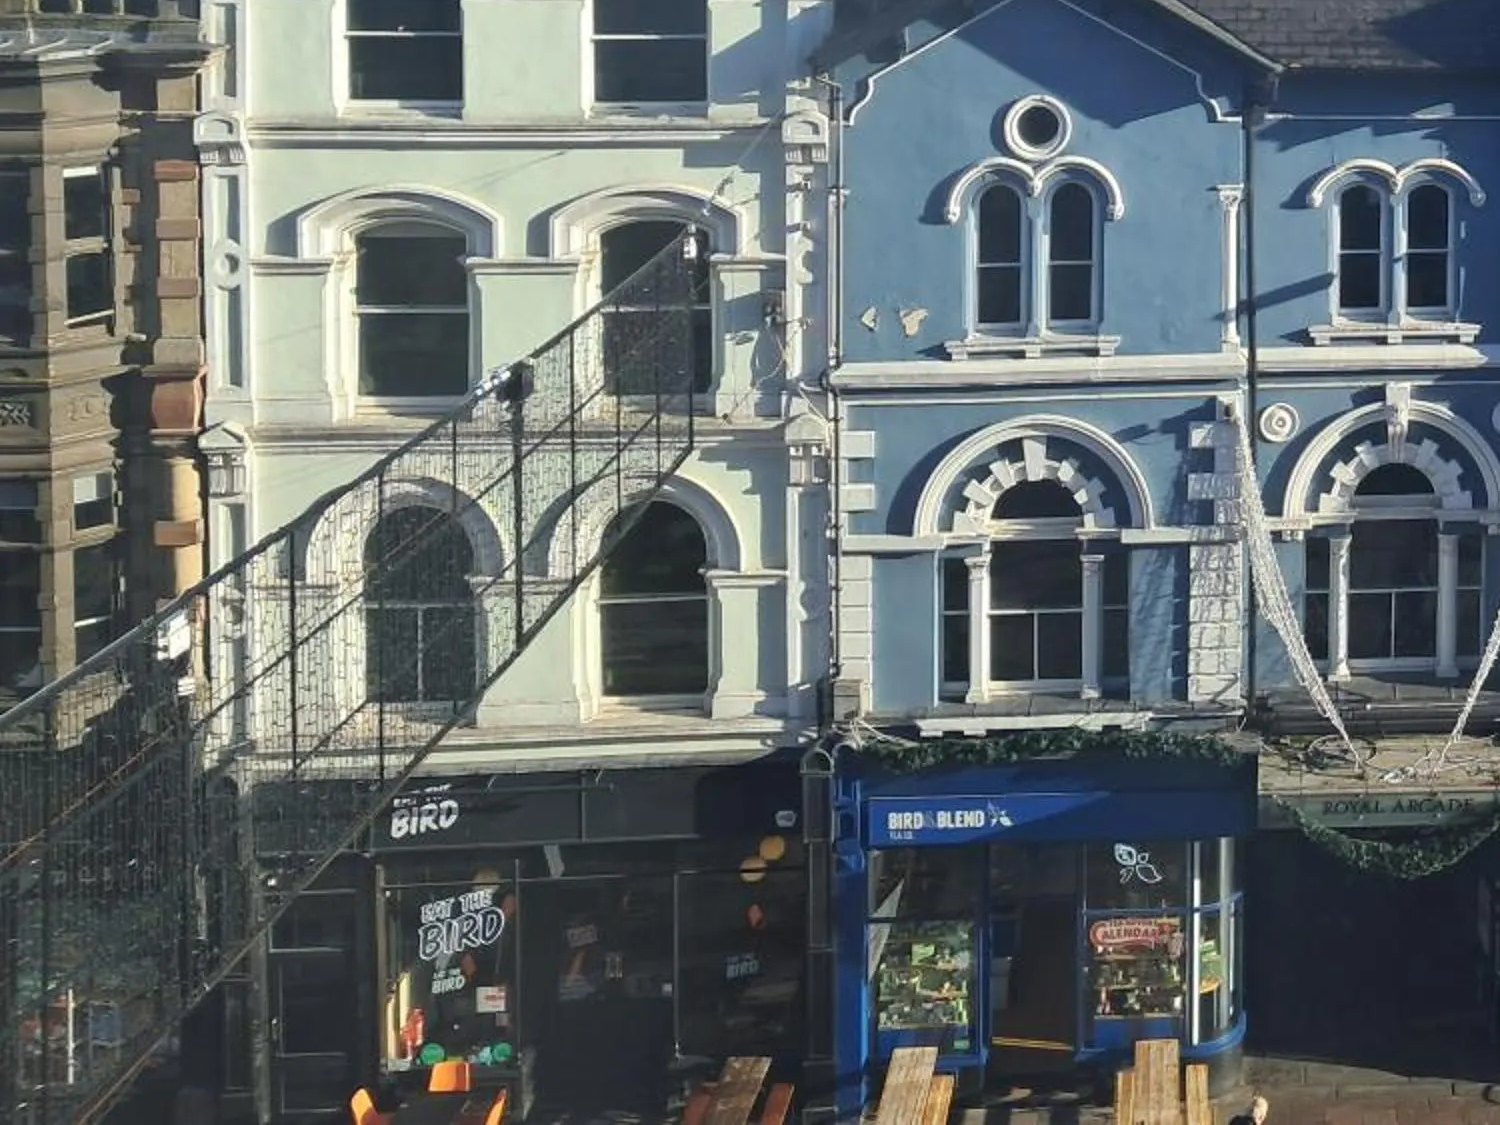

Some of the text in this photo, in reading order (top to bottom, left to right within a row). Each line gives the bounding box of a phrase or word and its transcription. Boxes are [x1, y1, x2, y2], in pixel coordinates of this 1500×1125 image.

[1323, 798, 1475, 815] ROYAL ARCADE
[391, 799, 459, 839] BIRD
[888, 812, 923, 830] BIRD
[936, 810, 985, 828] BLEND
[418, 907, 505, 960] BIRD
[431, 975, 466, 994] BIRD
